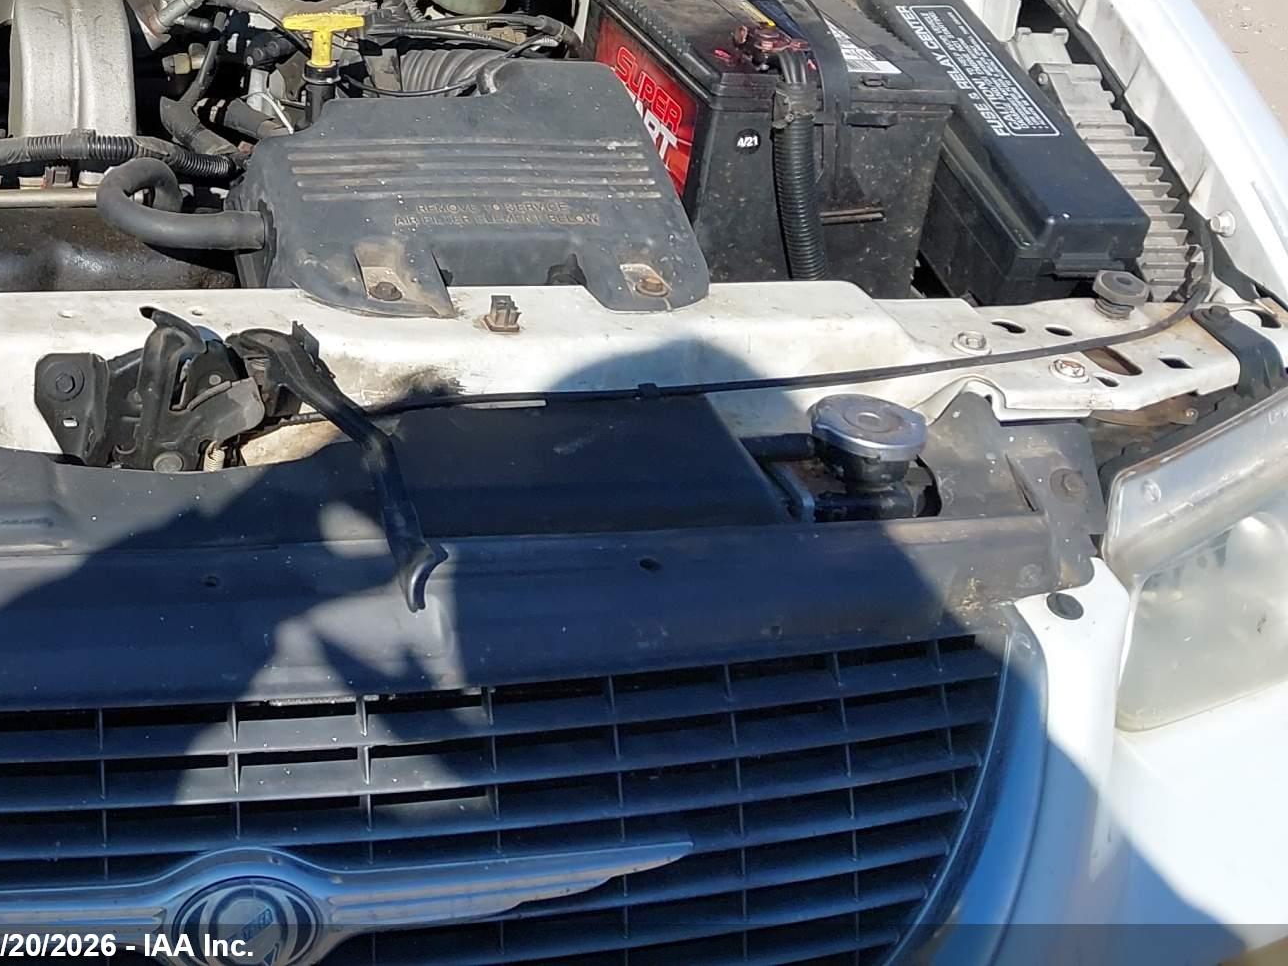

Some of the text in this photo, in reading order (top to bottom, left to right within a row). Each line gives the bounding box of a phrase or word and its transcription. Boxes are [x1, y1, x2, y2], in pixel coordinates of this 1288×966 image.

[895, 5, 939, 49] CENTER
[930, 51, 972, 89] RELAY
[614, 46, 683, 135] SUPER
[973, 103, 1011, 136] FUSE
[736, 135, 759, 147] 4/21
[394, 216, 419, 227] AIR
[547, 213, 601, 227] BELOW
[415, 204, 477, 214] REMOVE
[503, 201, 570, 213] SERVICE
